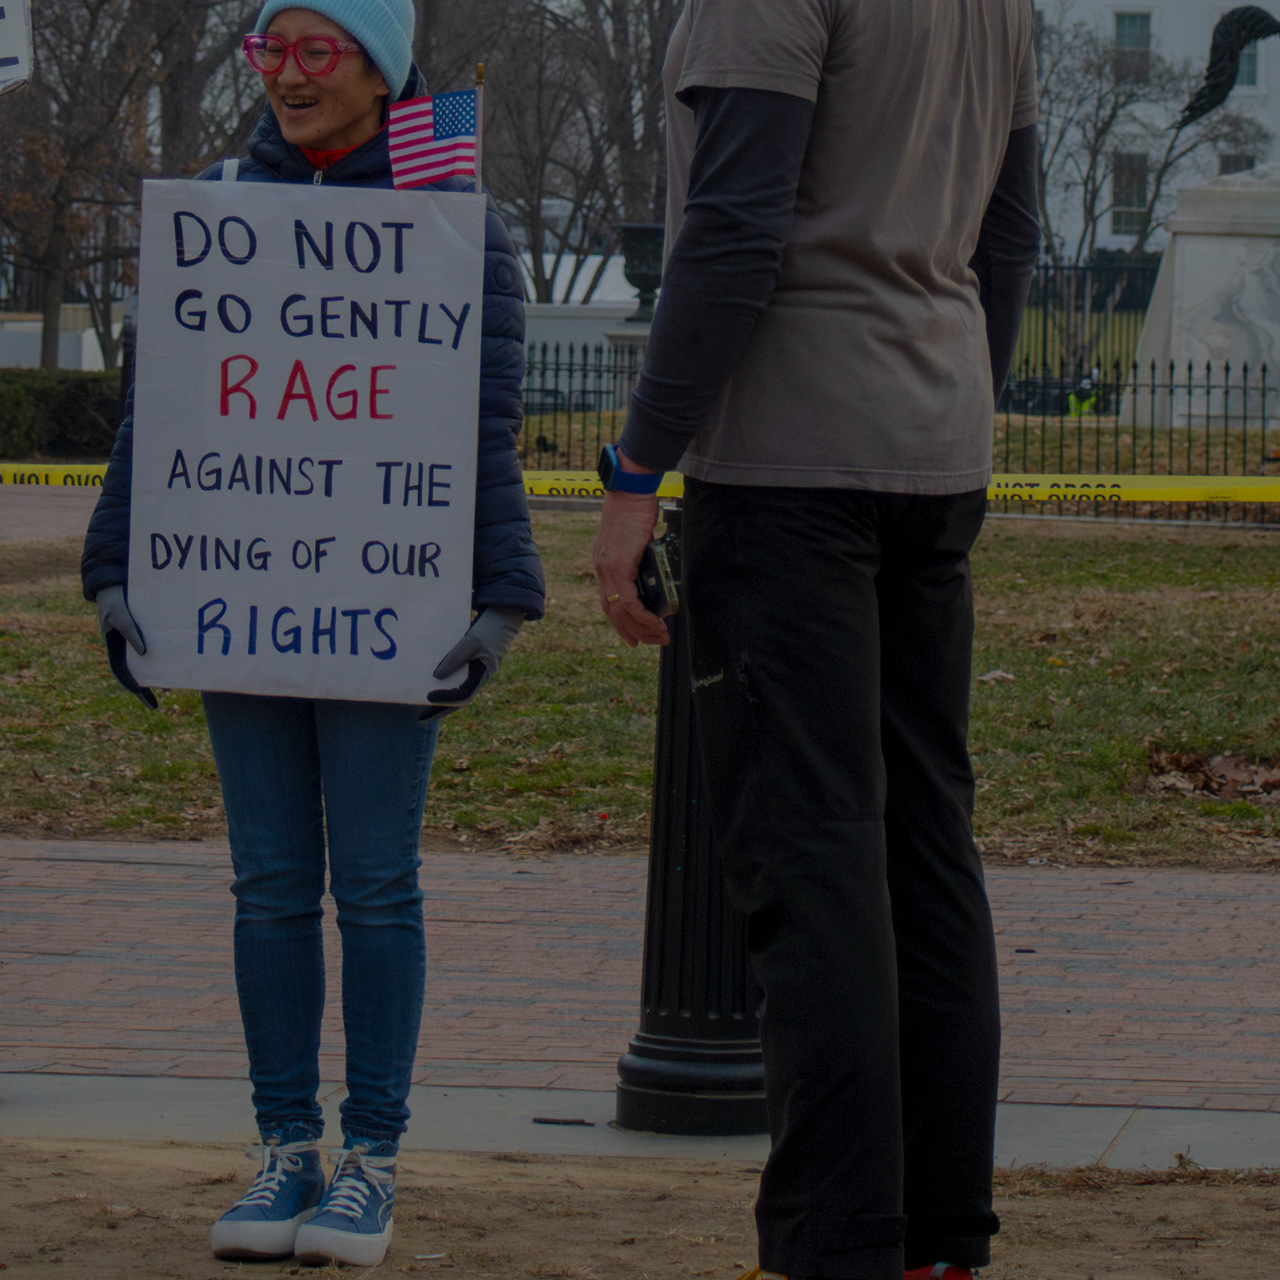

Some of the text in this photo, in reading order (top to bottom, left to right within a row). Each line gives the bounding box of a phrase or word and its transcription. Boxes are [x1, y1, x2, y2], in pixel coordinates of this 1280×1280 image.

[173, 211, 414, 273] DO NOT
[175, 289, 471, 350] GO GENTLY
[220, 354, 397, 422] RAGE
[167, 449, 452, 507] AGAINST THE
[150, 533, 441, 577] DYING OF OUR
[197, 597, 399, 660] RIGHTS
